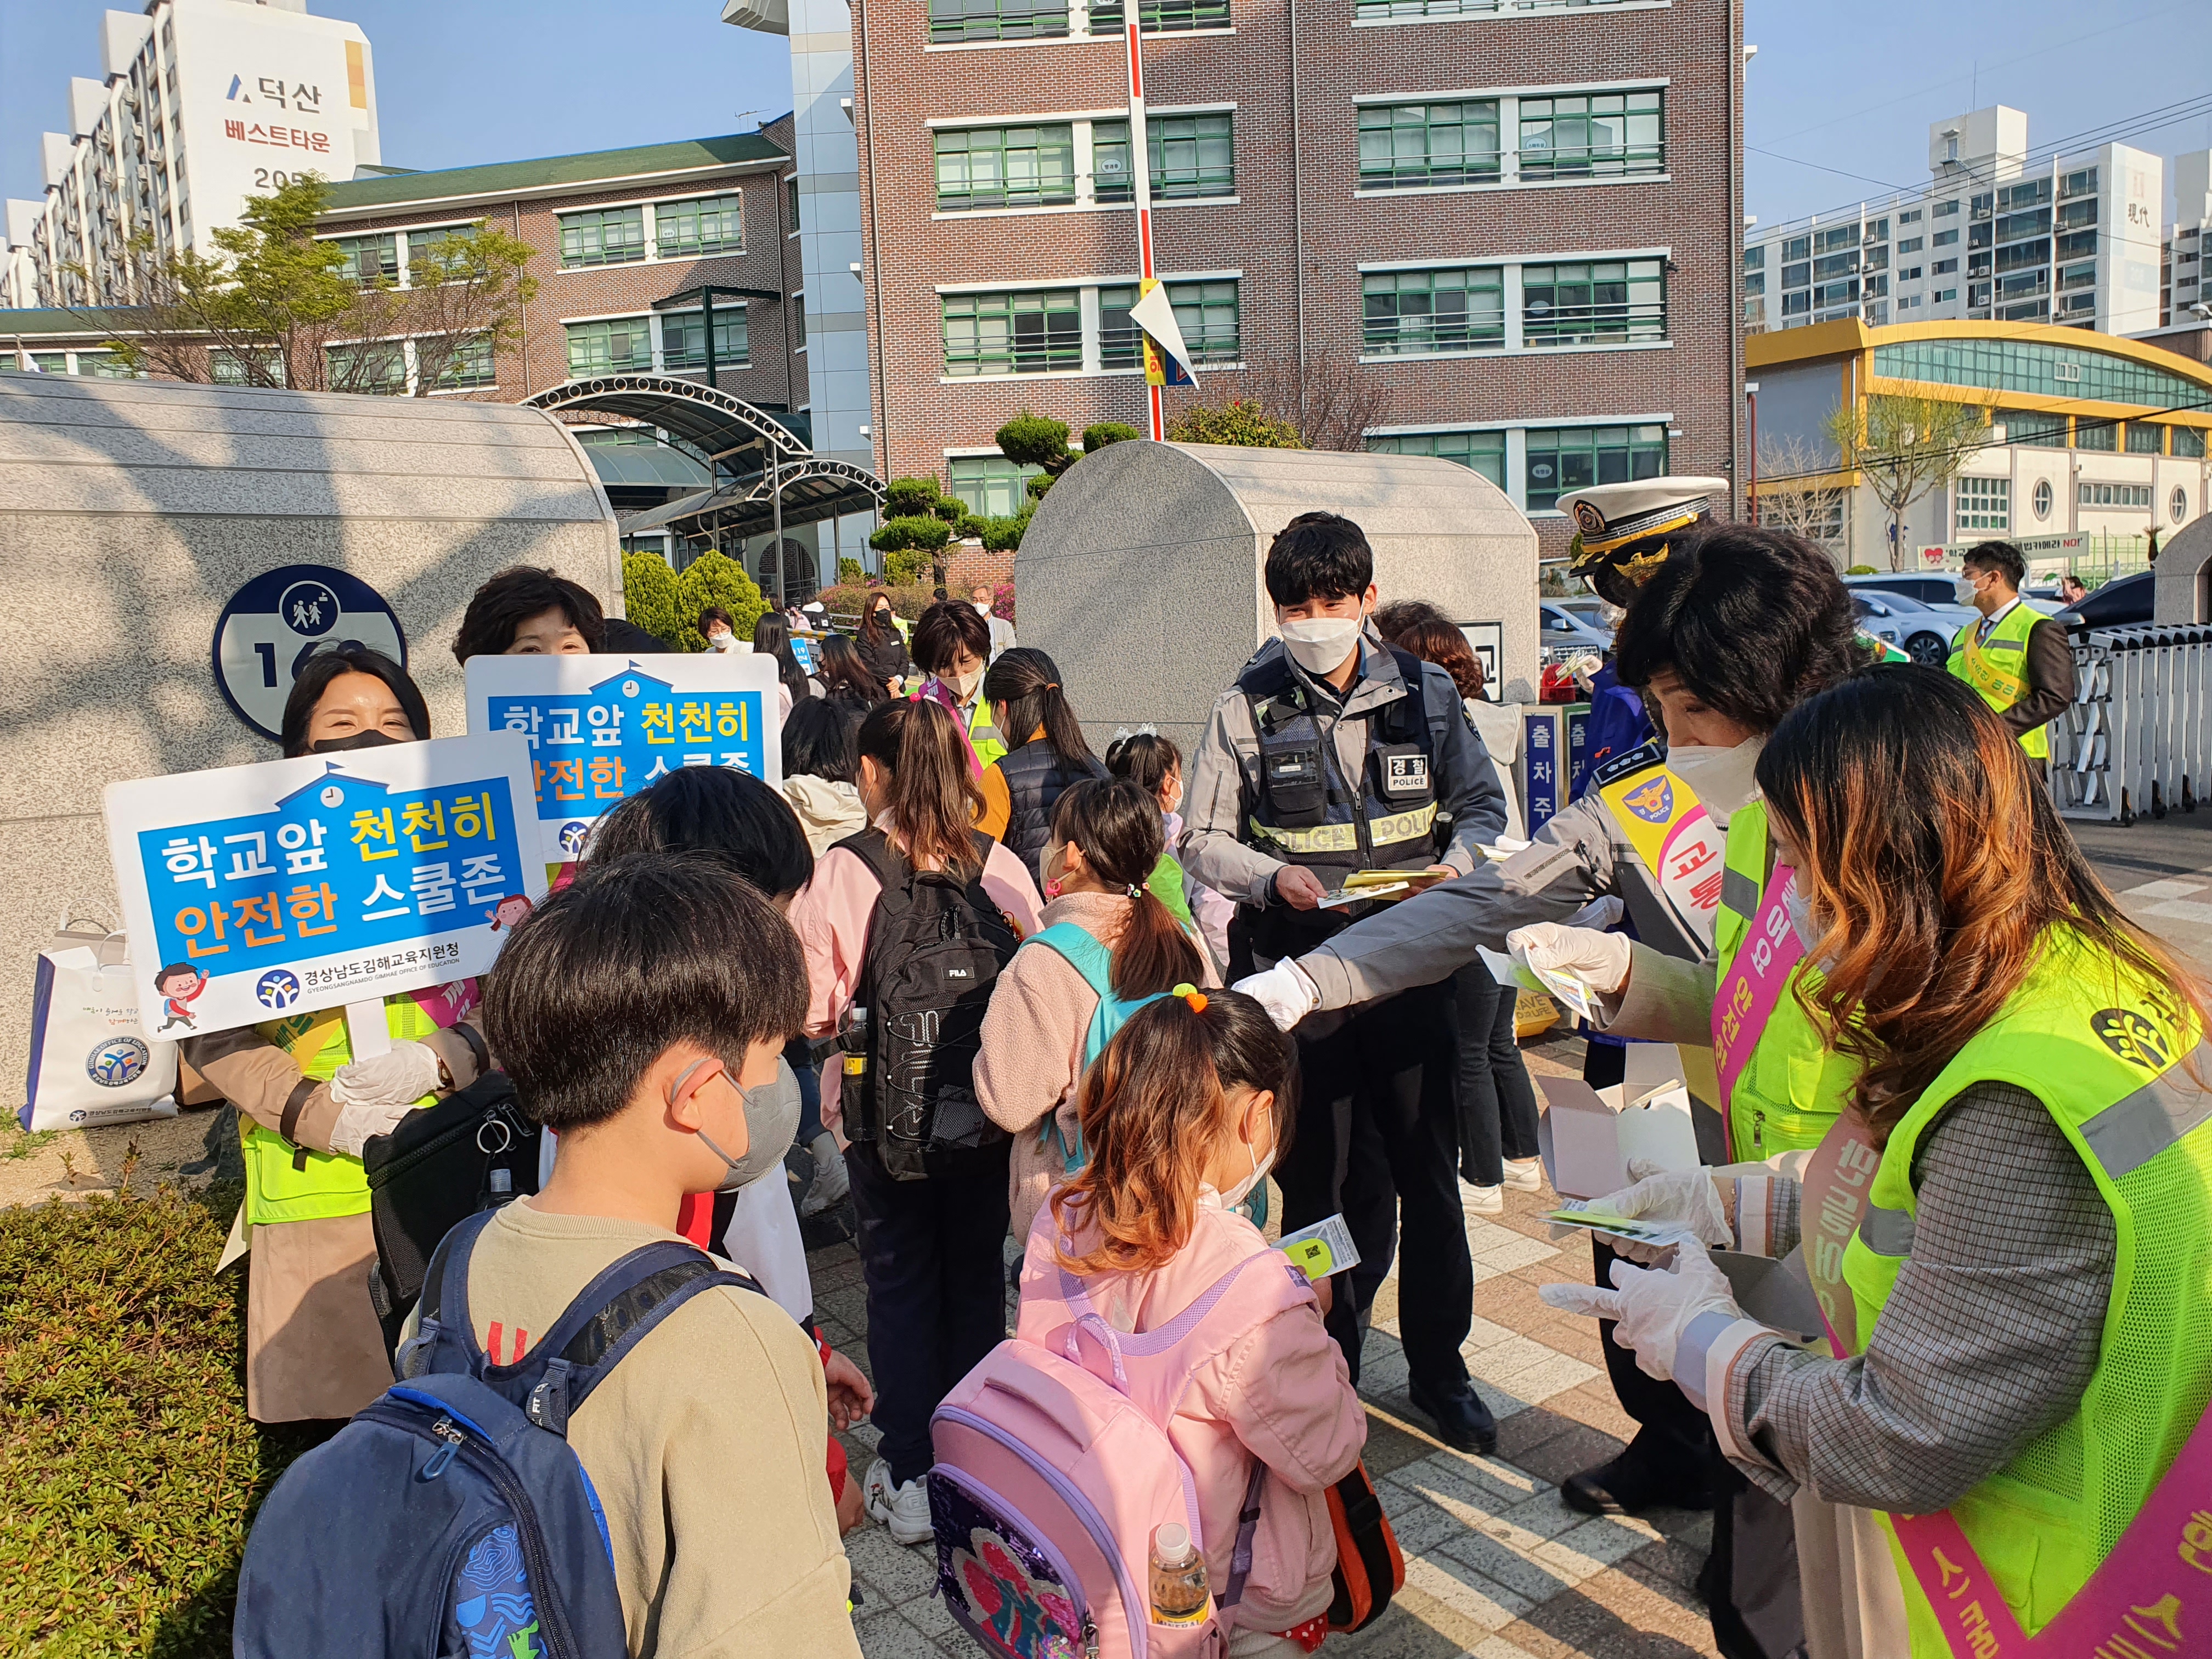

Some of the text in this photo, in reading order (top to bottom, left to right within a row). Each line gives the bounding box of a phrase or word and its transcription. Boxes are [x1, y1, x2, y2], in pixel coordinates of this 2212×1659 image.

[258, 77, 323, 114] 덕산
[224, 119, 331, 153] 베스트타운
[503, 701, 748, 749] 학교앞 천천히
[1392, 777, 1425, 786] POLICE
[1649, 805, 1671, 821] POLICE
[161, 791, 496, 889] 학교앞 천천히
[174, 853, 506, 959] 안전한 스쿨존
[304, 942, 459, 986] 경상남도김해교육지원청
[307, 976, 373, 994] GYEONGSANGNAMDO
[374, 970, 398, 980] GIMHAE
[399, 966, 418, 975] OFFICE
[427, 957, 460, 969] EDUCATION
[949, 969, 967, 977] FILA
[100, 1038, 122, 1049] OFFICE
[132, 1039, 148, 1065] EDUCATION
